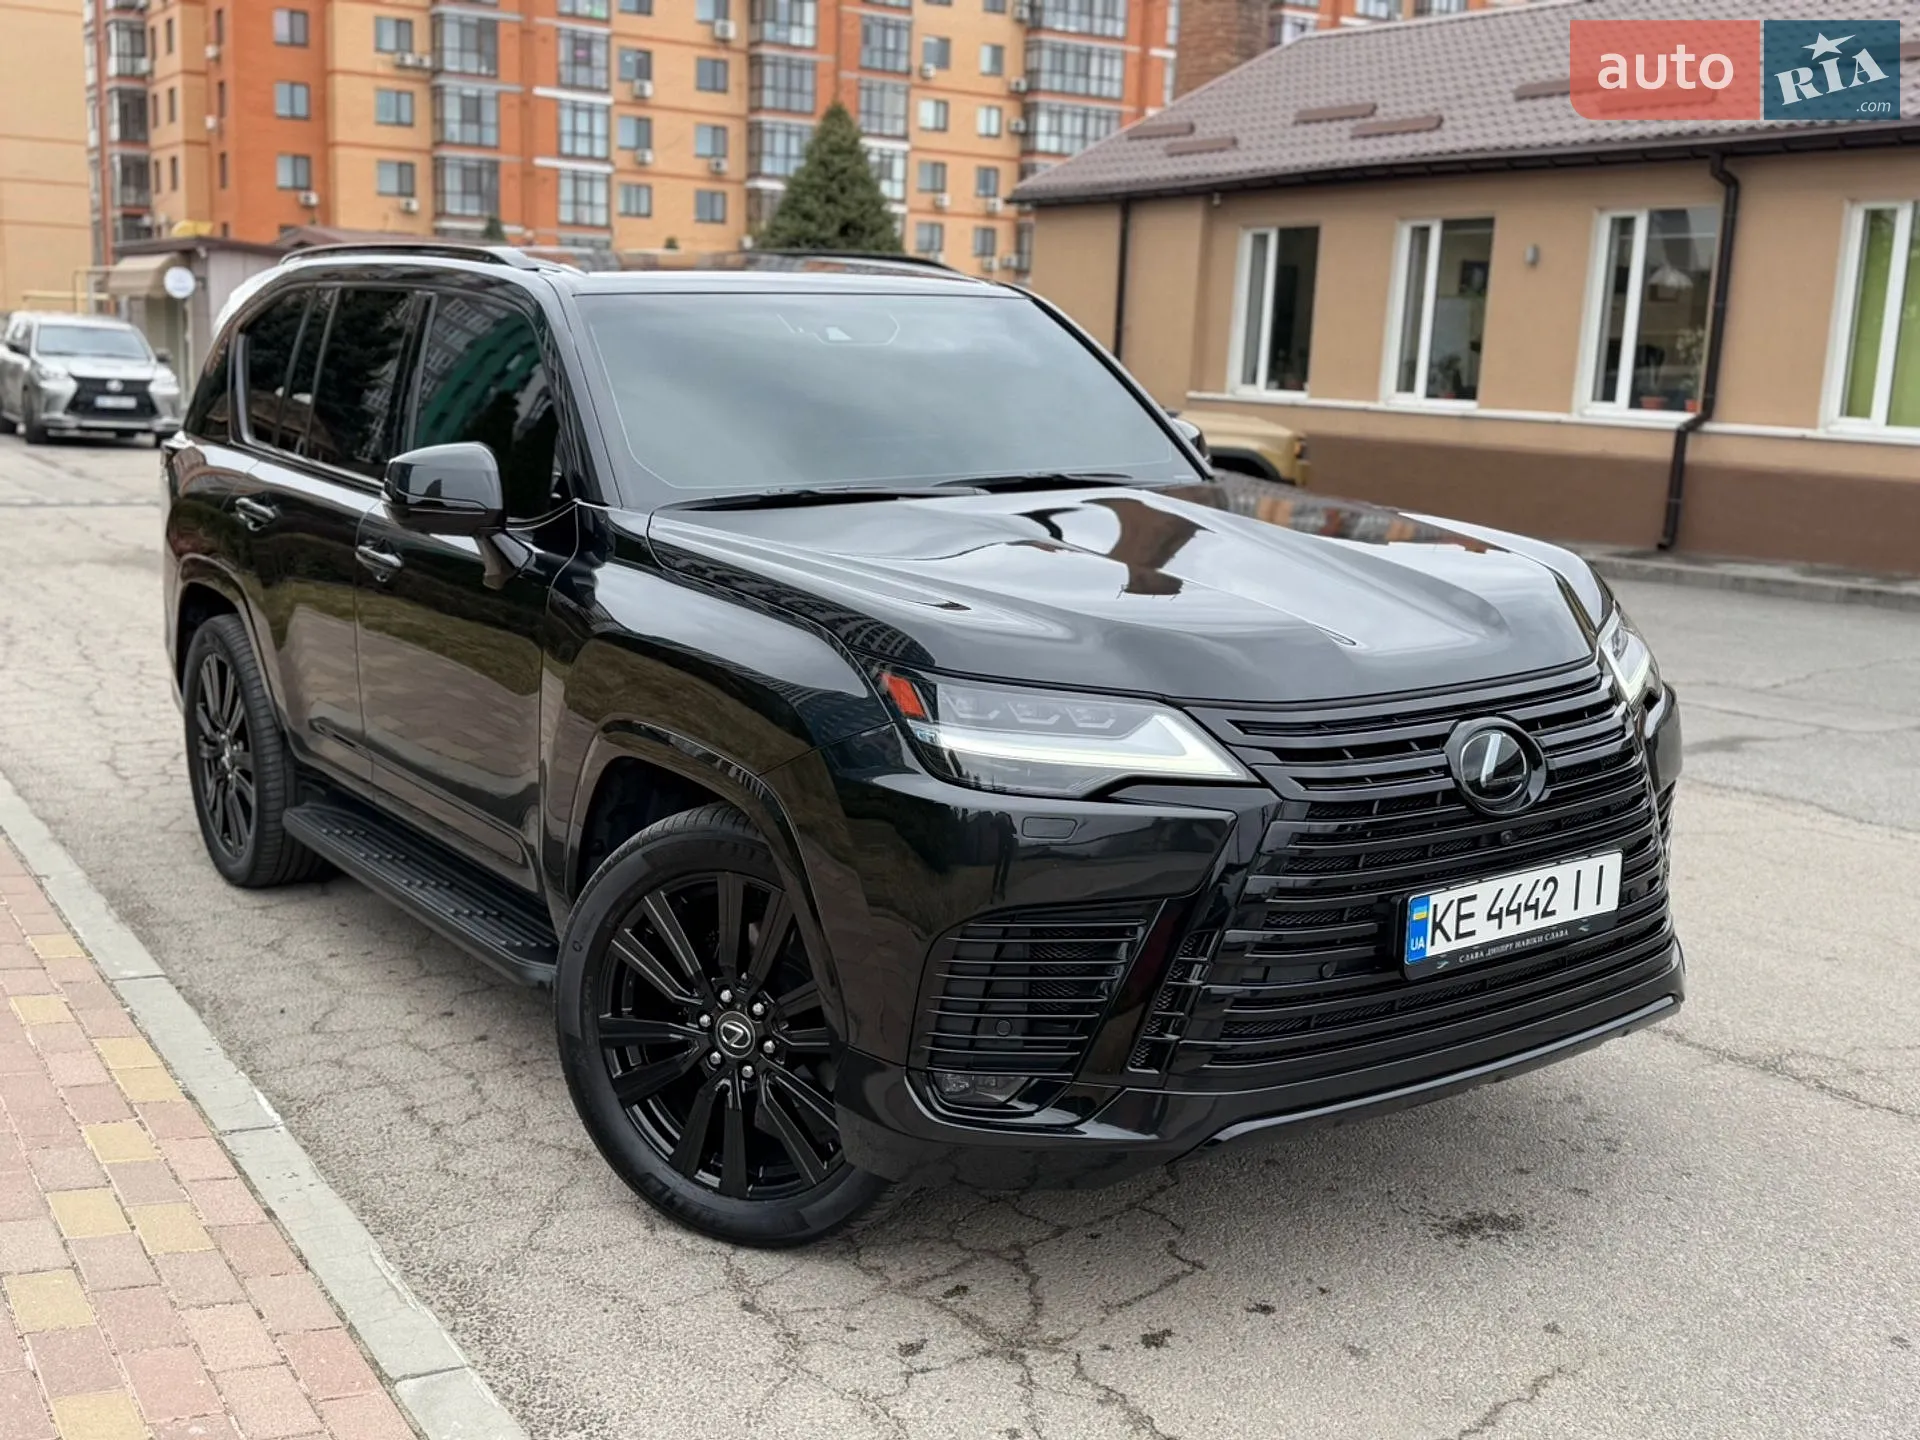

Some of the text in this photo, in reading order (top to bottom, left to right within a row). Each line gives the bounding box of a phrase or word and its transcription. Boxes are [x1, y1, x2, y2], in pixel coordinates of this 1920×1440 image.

[1430, 894, 1478, 947] KE
[1486, 876, 1560, 931] 4442
[1411, 936, 1425, 951] UA
